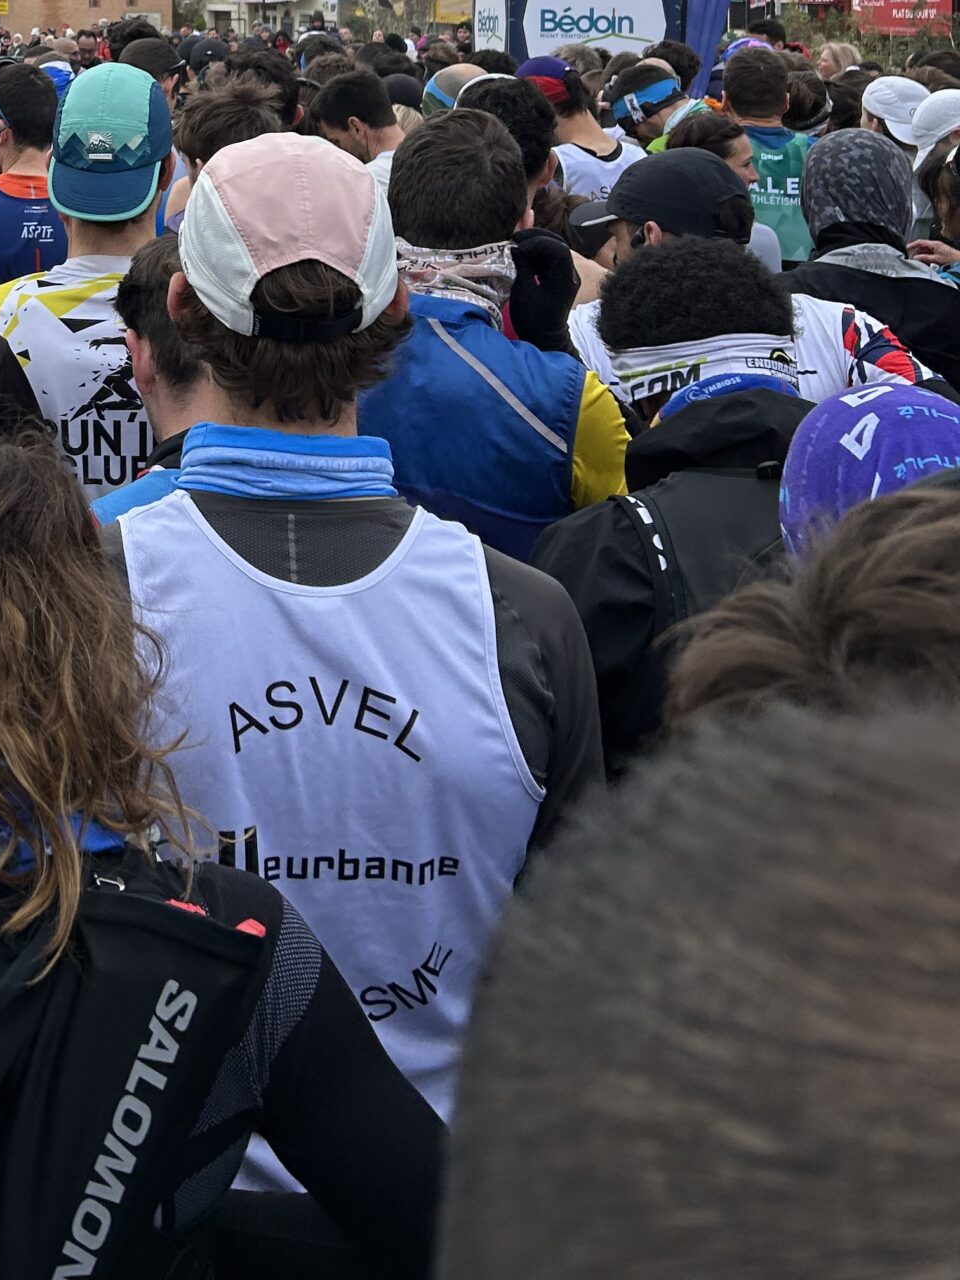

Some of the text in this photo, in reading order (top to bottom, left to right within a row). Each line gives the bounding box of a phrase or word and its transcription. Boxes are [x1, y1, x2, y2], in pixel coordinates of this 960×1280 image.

[540, 7, 634, 34] Bédoin
[229, 676, 421, 763] ASVEL
[50, 978, 198, 1280] SALOMON
